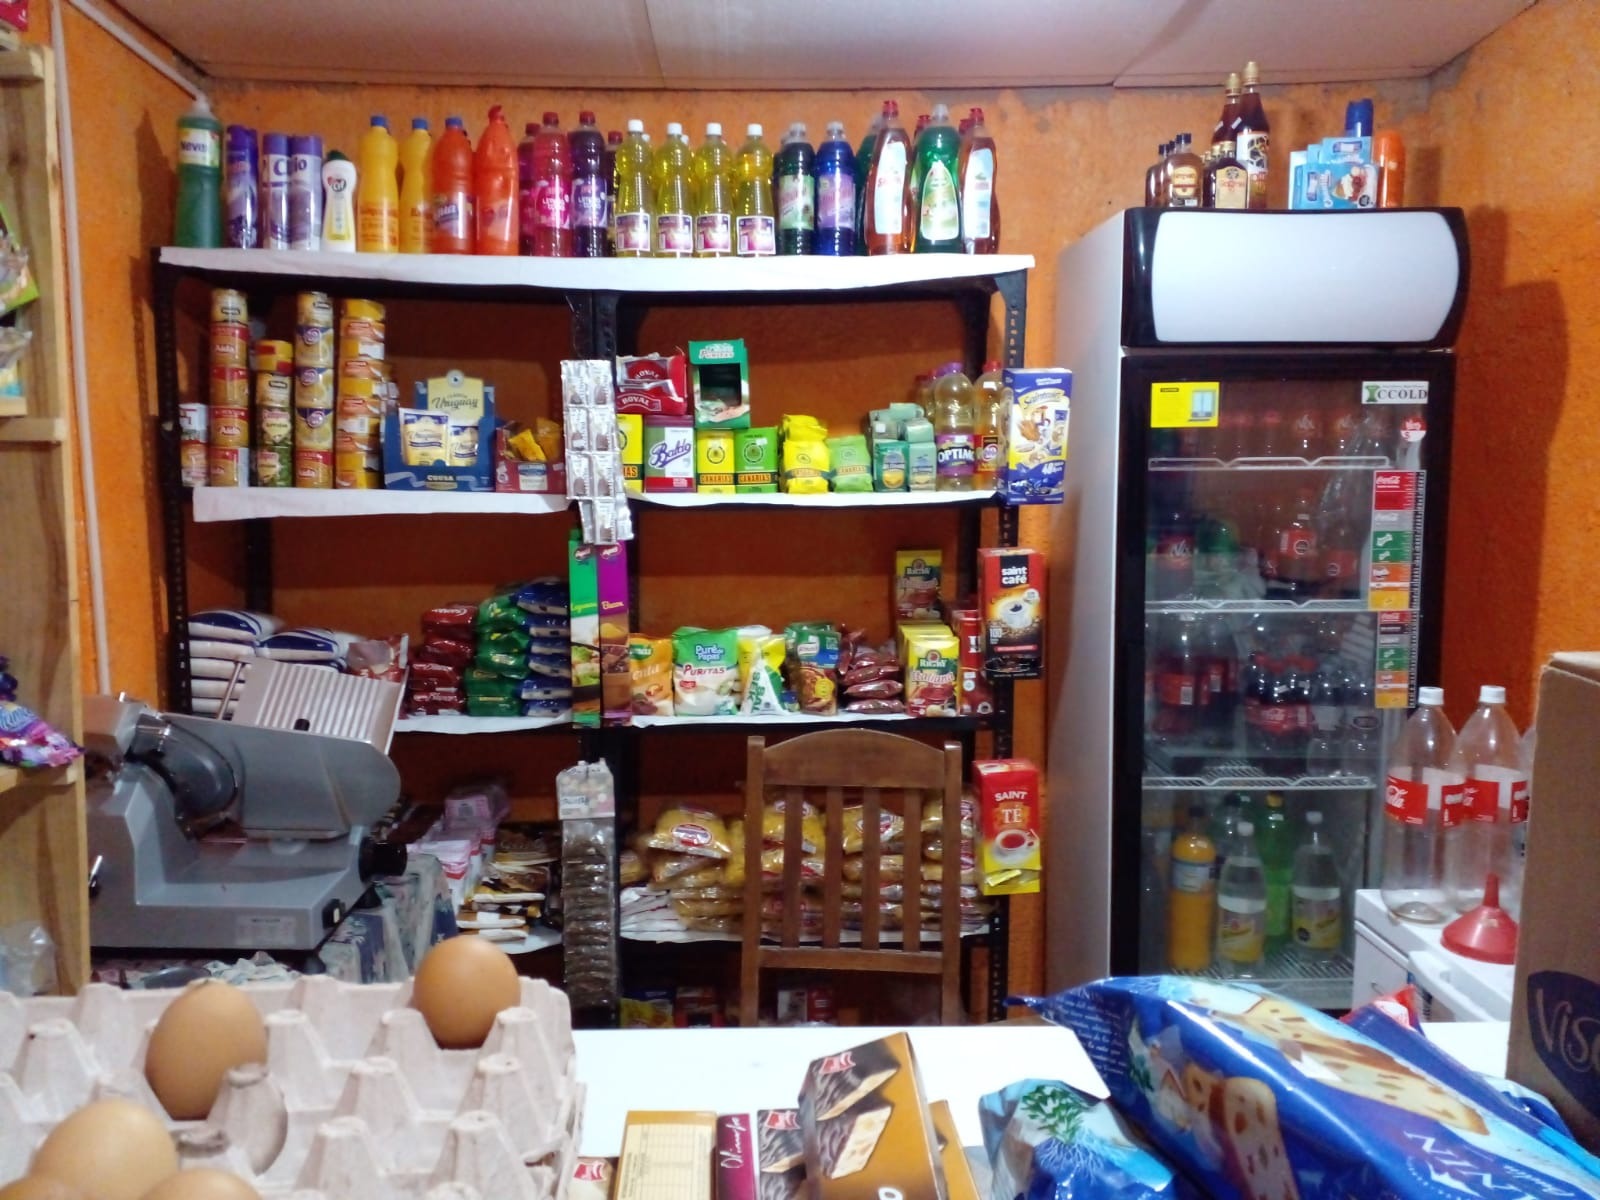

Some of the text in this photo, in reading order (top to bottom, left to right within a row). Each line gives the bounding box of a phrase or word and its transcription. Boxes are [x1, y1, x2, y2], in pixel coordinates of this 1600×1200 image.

[1001, 566, 1028, 576] saint
[1001, 574, 1028, 585] café
[994, 790, 1028, 802] SAINT
[1001, 804, 1023, 824] TÉ
